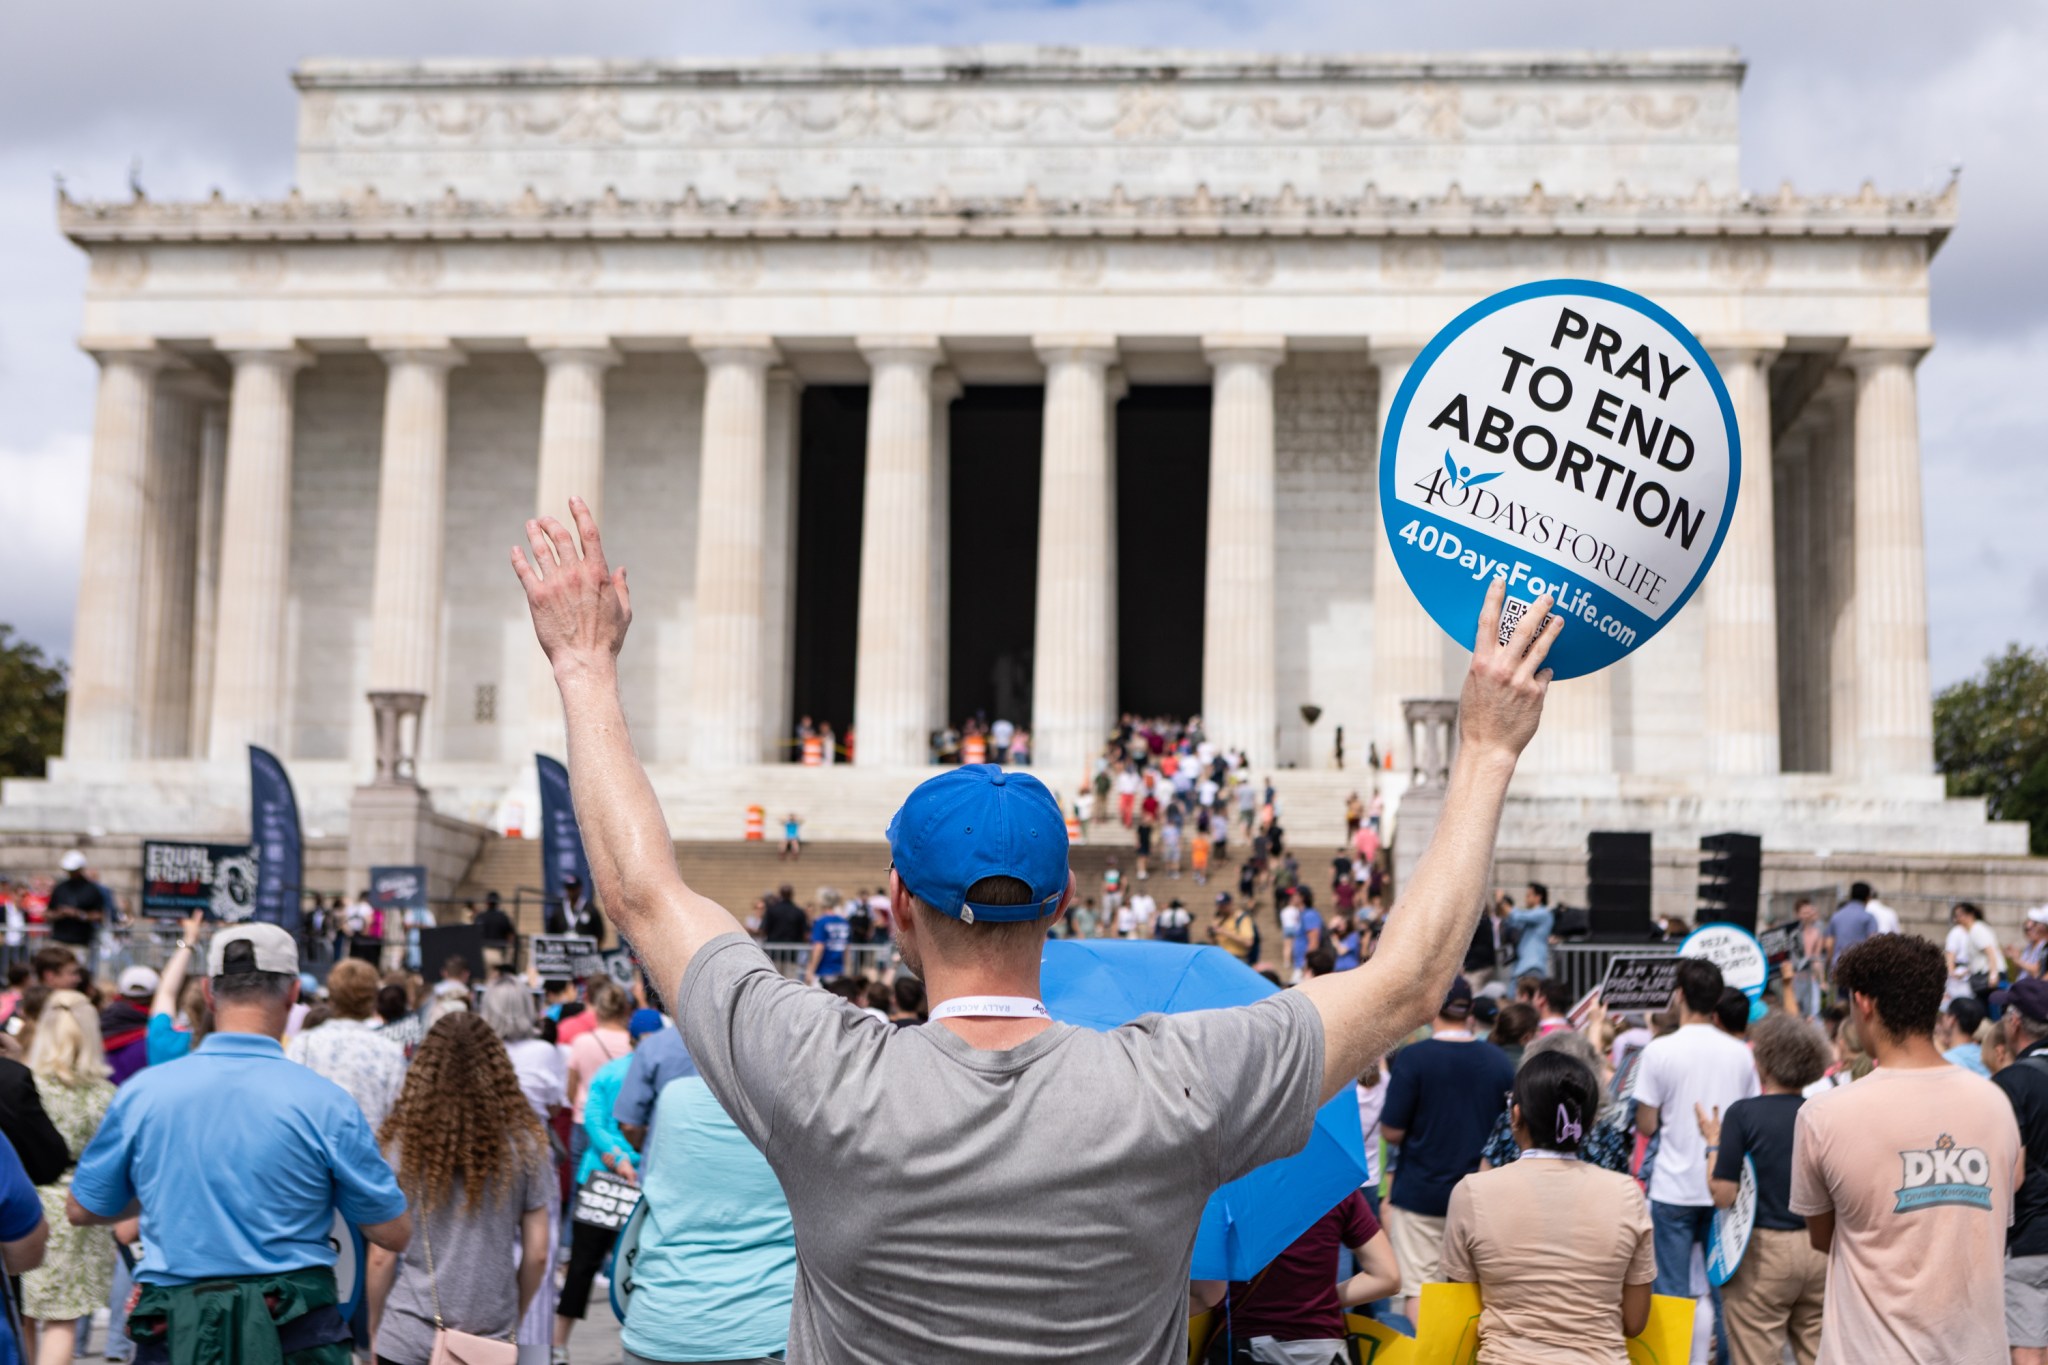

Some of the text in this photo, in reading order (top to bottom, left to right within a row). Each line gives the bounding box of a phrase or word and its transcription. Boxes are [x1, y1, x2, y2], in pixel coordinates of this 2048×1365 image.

[1550, 307, 1690, 401] PRAY
[1500, 346, 1695, 472] TO END
[1428, 393, 1706, 551] ABORTION
[1413, 467, 1667, 604] 40 DAYS FOR LIFE
[1398, 520, 1637, 648] 40DaysForLife.com
[147, 845, 214, 867] EQUAL
[1606, 977, 1677, 992] PRO-LIFE
[1613, 965, 1678, 977] I AM THE
[946, 1004, 1010, 1013] RALLY ACCESS
[1602, 991, 1671, 1003] GENERATION
[1898, 1147, 1990, 1189] DKO
